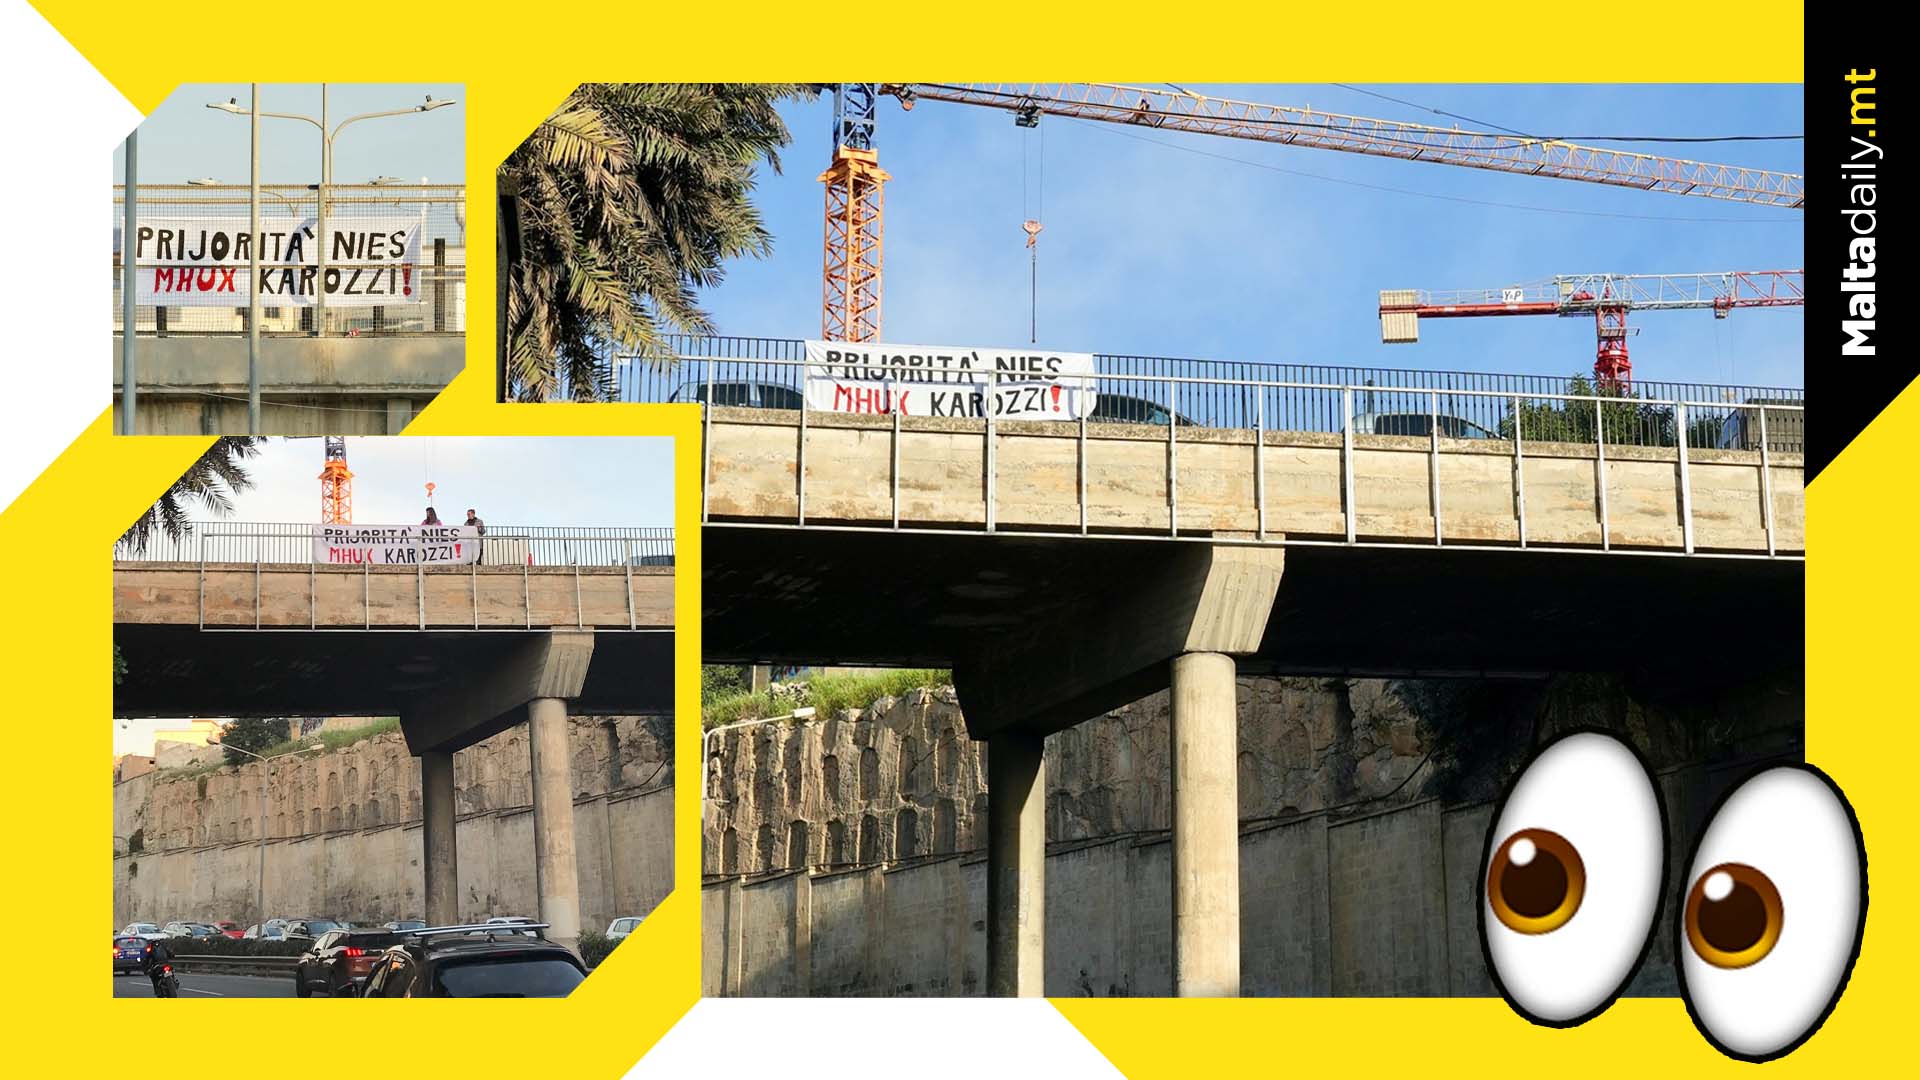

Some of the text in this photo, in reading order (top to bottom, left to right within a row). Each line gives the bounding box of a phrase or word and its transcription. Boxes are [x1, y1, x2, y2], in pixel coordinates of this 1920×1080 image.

[332, 230, 406, 260] NIES
[154, 263, 412, 296] MHUX KAROZZI!
[995, 356, 1063, 383] NIES
[421, 528, 460, 544] NIES
